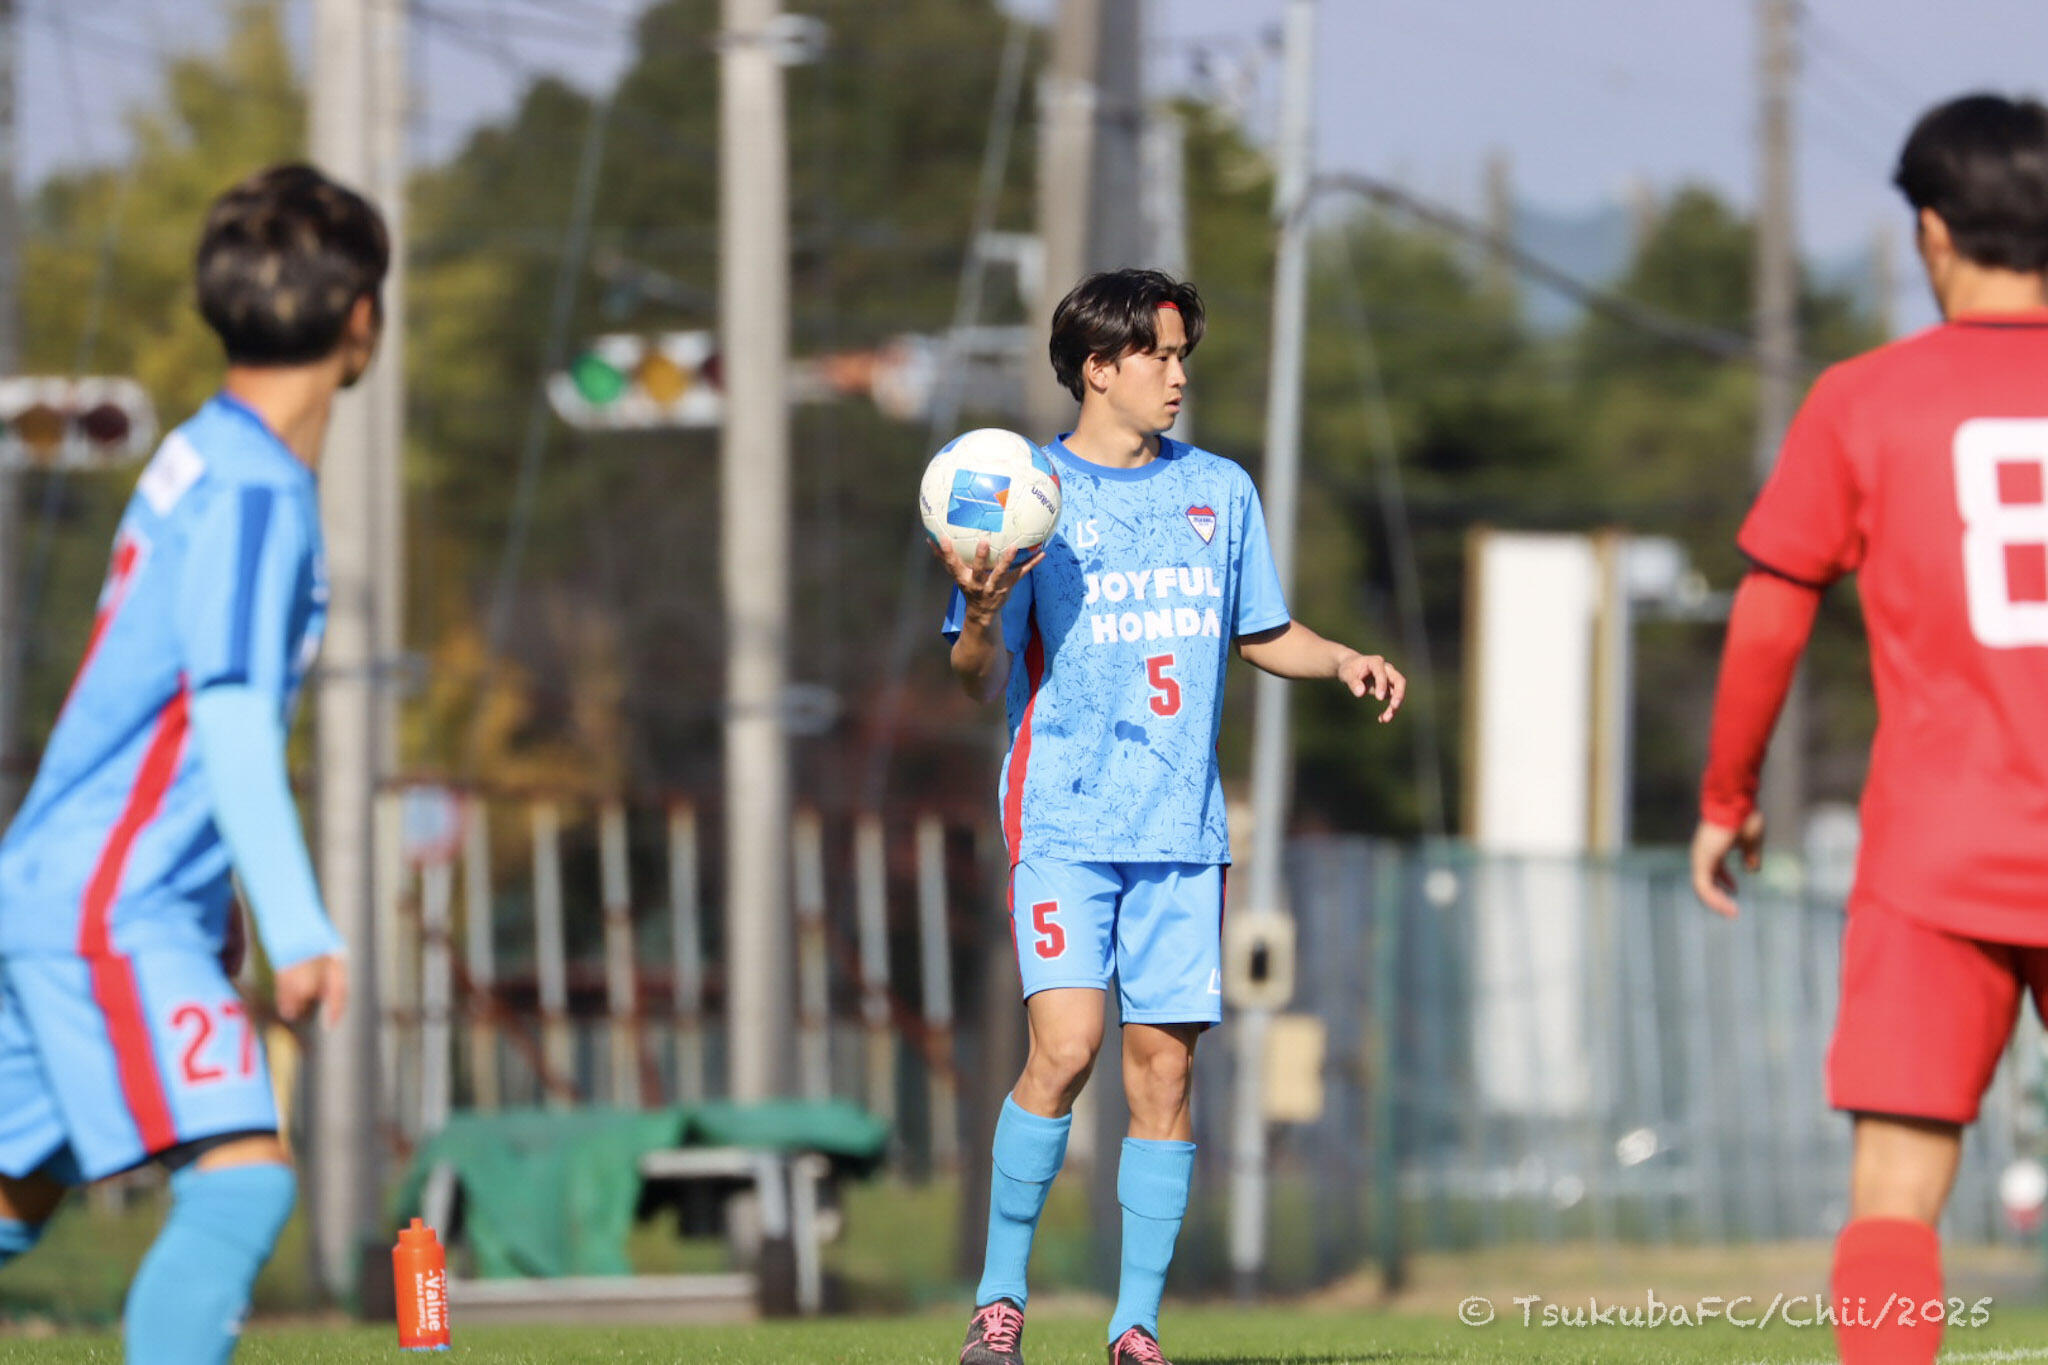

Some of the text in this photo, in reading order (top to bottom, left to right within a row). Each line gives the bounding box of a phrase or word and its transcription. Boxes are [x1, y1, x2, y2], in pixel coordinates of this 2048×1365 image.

[1952, 416, 2048, 650] 8
[1084, 566, 1221, 604] JOYFUL
[1091, 606, 1221, 645] HONDA
[1144, 653, 1182, 718] 5
[1031, 900, 1067, 960] 5
[170, 1004, 259, 1084] 27
